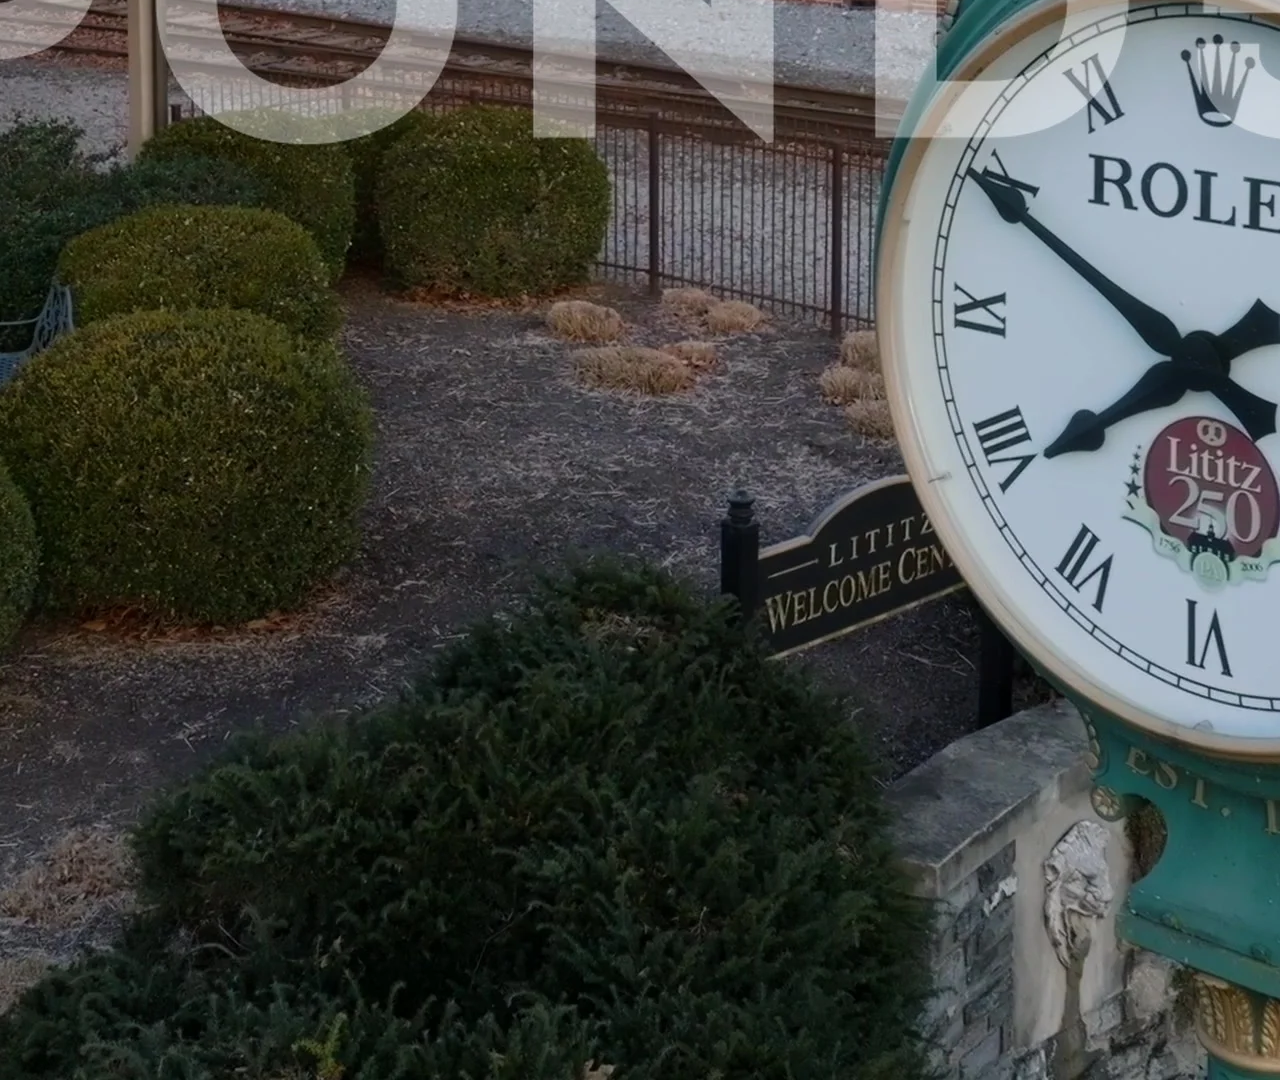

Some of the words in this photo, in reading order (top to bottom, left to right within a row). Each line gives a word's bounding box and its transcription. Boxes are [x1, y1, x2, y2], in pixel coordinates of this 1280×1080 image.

[1166, 435, 1263, 493] Lititz
[1167, 475, 1262, 544] 250
[828, 511, 934, 568] LITITZ
[1240, 562, 1264, 573] 2006
[765, 560, 893, 634] WELCOME
